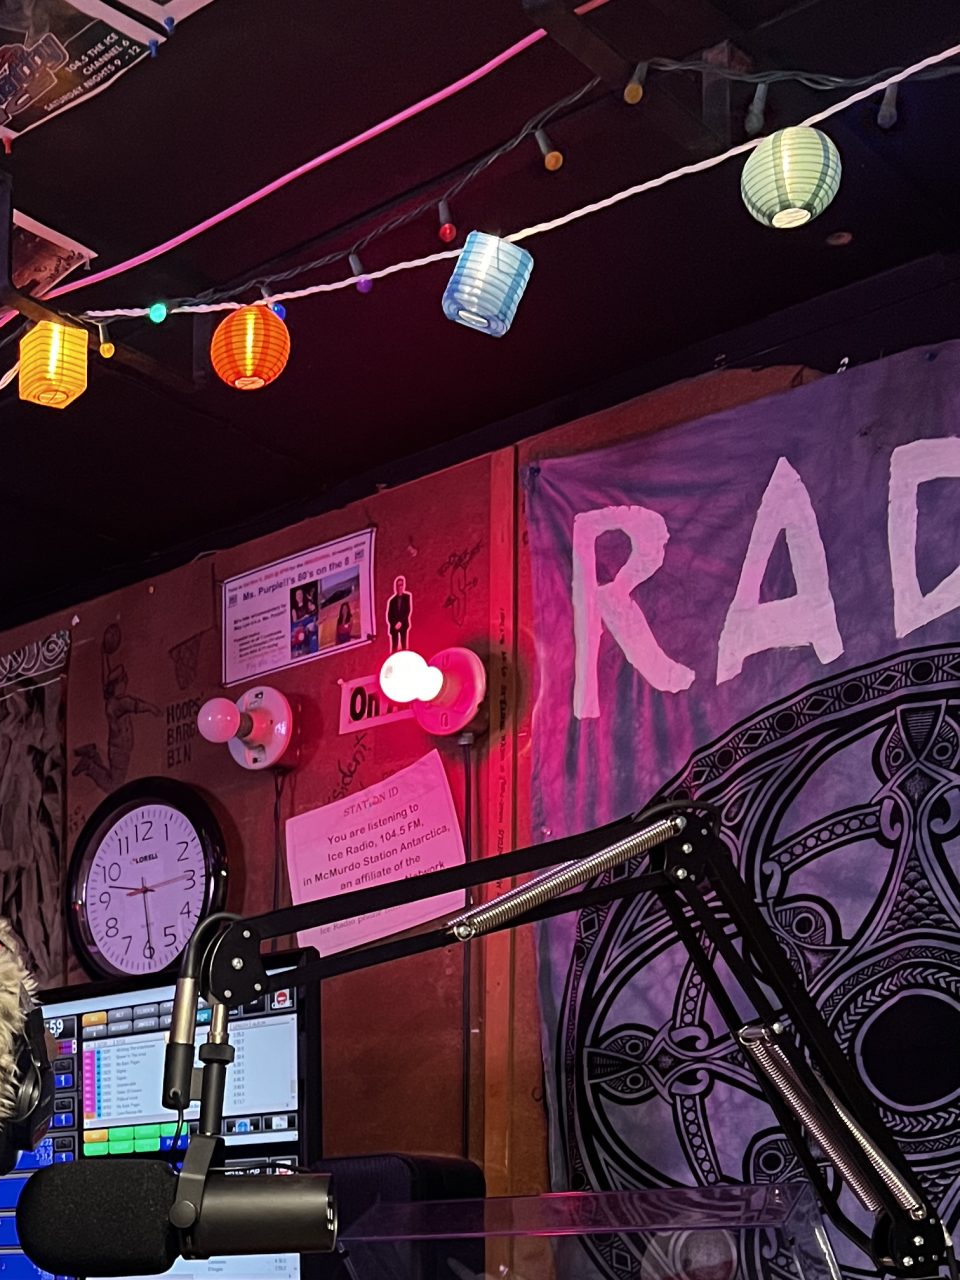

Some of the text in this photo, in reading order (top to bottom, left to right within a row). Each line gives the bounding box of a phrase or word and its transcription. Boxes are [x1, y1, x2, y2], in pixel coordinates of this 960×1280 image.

[65, 32, 119, 73] 104.5 THE ICE
[82, 44, 123, 75] CHANNEL
[44, 86, 83, 112] SATURDAY
[83, 64, 115, 89] NIGHTS
[128, 45, 141, 56] 12
[242, 591, 256, 601] Ms.
[316, 566, 327, 576] on
[329, 560, 342, 571] the
[350, 685, 380, 720] On
[167, 745, 191, 768] BIN
[389, 786, 399, 799] ID
[134, 821, 154, 843] 12
[164, 823, 168, 841] 1
[327, 803, 419, 845] You are listening to
[118, 836, 129, 856] 11
[176, 841, 189, 862] 2
[327, 818, 425, 863] Ice Radio, 104.5 FM,
[303, 825, 451, 887] in McMurdo Station Antarctica,
[102, 862, 121, 884] 10
[183, 870, 196, 890] 3
[340, 855, 421, 890] an affiliate of the
[99, 891, 111, 911] 9
[179, 901, 191, 919] 4
[105, 917, 119, 938] 8
[164, 925, 177, 947] 5
[121, 936, 132, 955] 7
